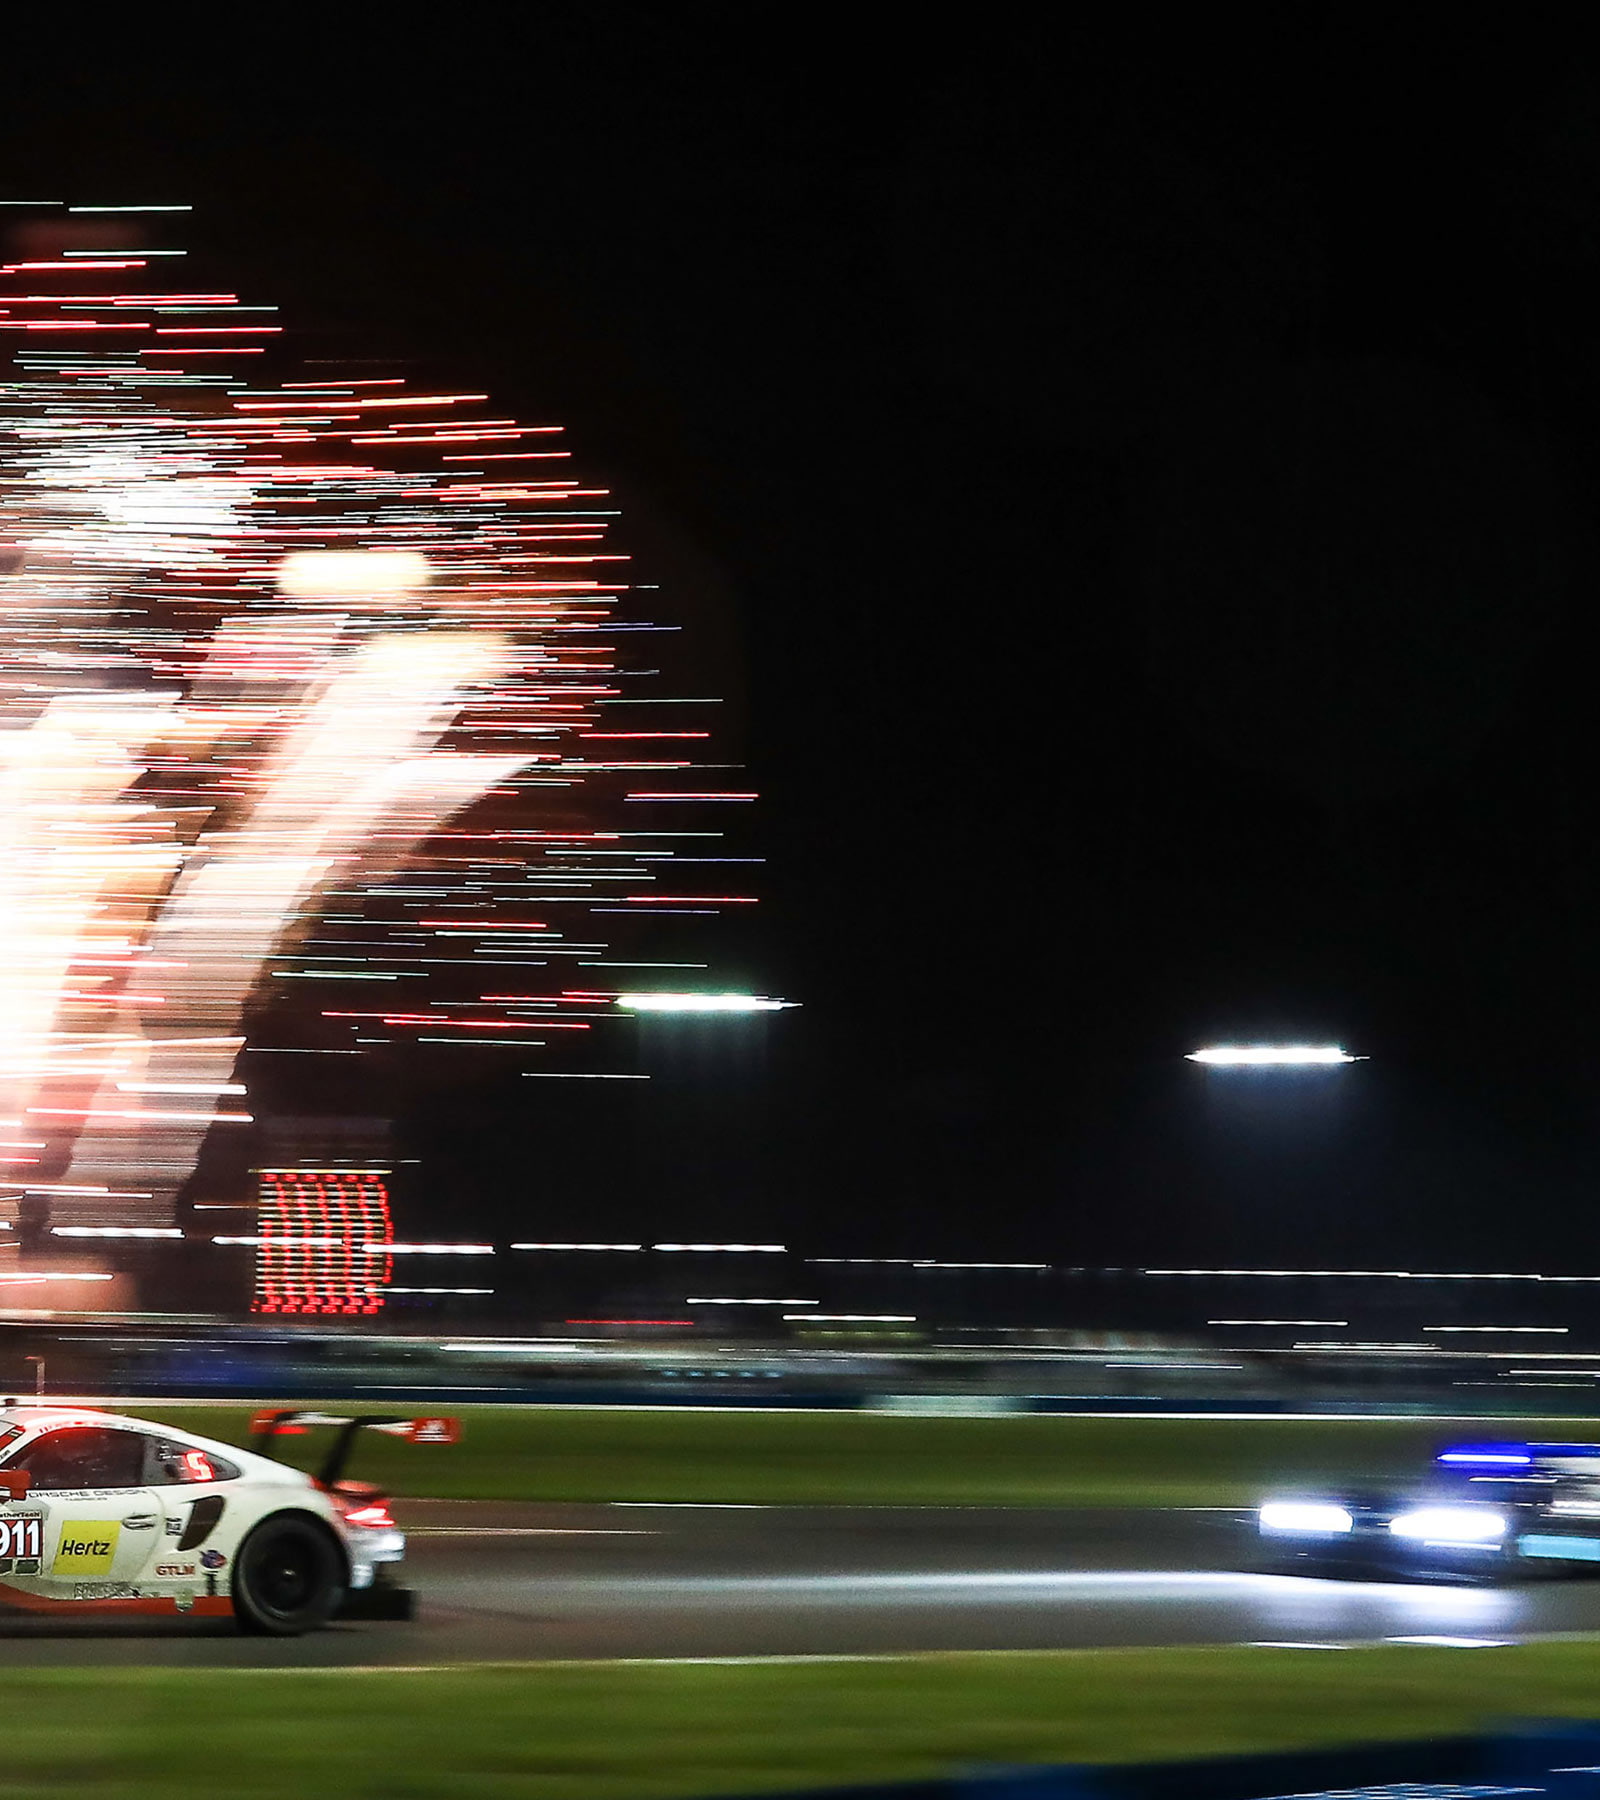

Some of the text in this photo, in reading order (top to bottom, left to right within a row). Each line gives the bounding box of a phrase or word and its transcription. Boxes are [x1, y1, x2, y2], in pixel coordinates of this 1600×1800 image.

[28, 1489, 89, 1499] ORSCHE
[60, 1539, 111, 1556] Hertz
[155, 1565, 196, 1576] GTLM
